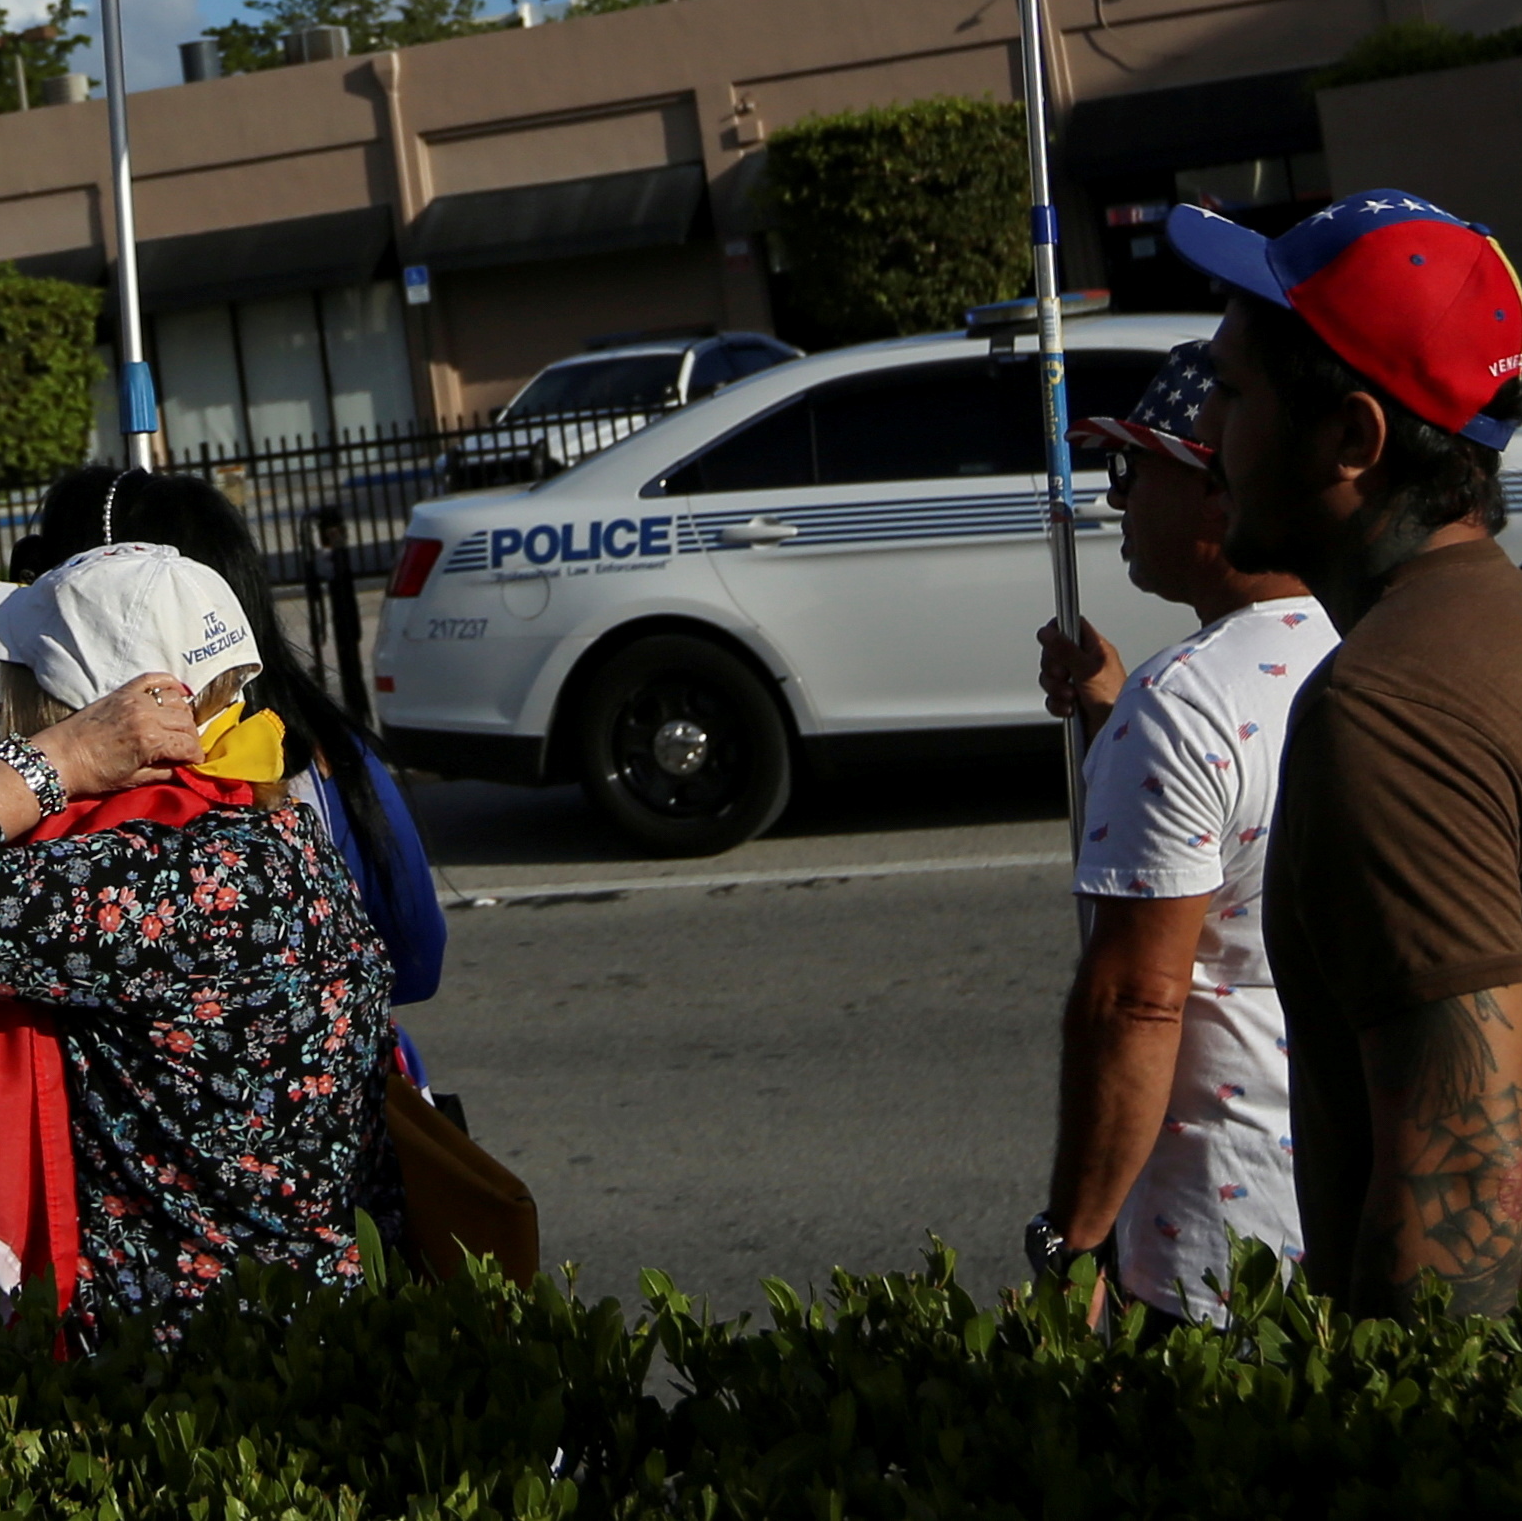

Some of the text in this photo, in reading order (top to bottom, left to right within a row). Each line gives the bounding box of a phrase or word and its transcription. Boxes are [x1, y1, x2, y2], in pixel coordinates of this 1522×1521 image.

[491, 515, 673, 569] POLICE
[203, 611, 217, 626] TE
[204, 621, 227, 641] AMO
[182, 625, 248, 665] VENEZUELA
